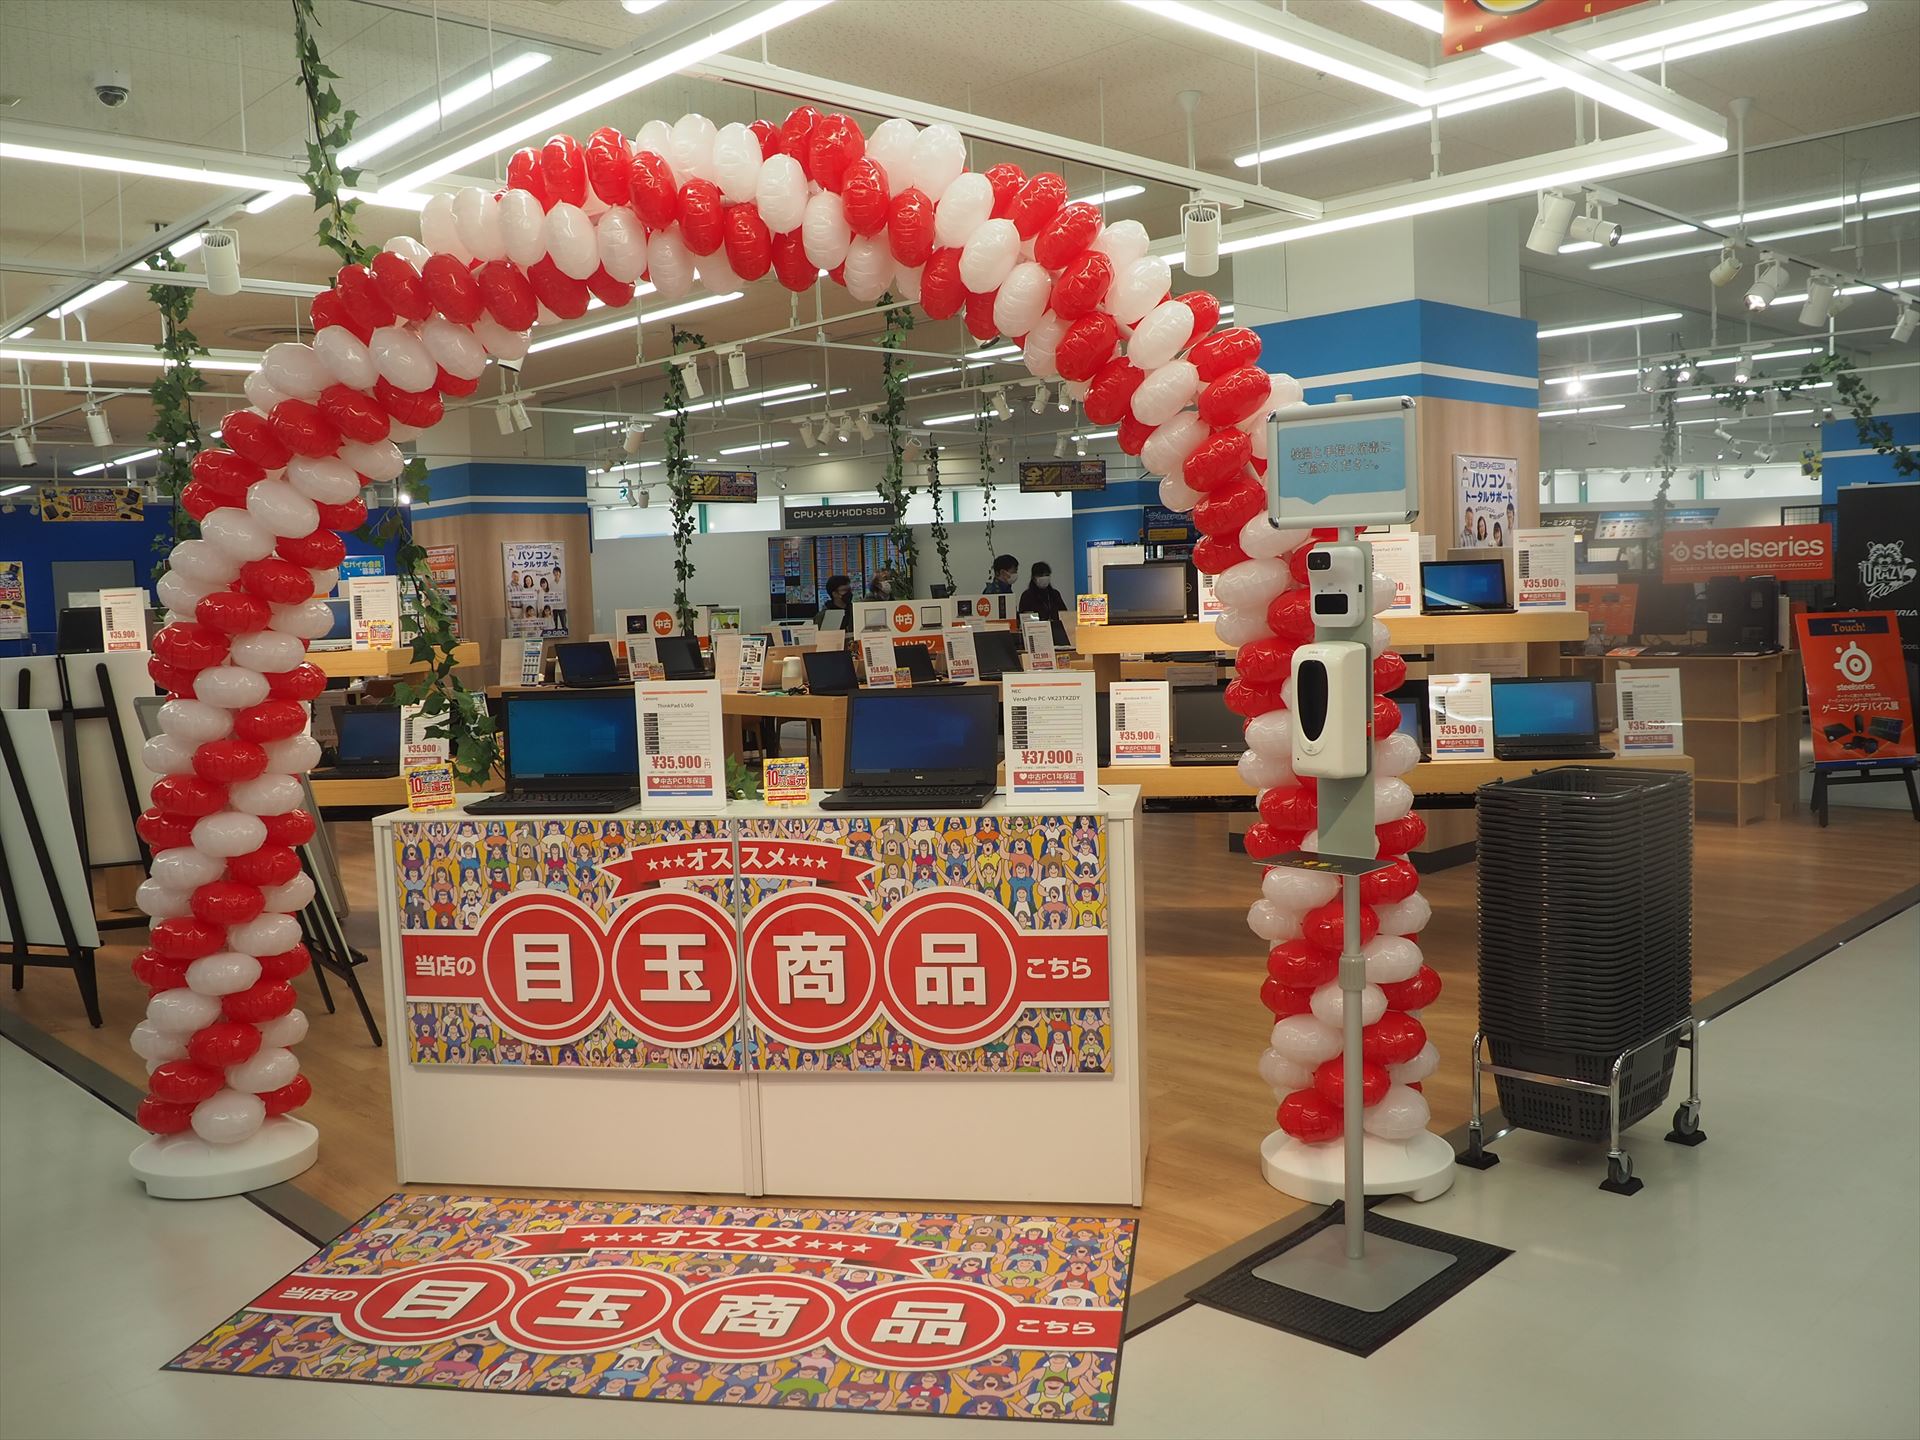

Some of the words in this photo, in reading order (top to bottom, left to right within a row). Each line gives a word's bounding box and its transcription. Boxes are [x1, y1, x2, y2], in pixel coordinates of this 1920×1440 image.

[1472, 473, 1506, 488] パソコン
[1465, 490, 1513, 503] トータルサポート
[1692, 536, 1825, 561] steelseries
[518, 551, 552, 560] パソコン
[511, 561, 560, 569] トータルサポート
[1523, 579, 1559, 589] ¥35,900
[977, 604, 990, 613] 中古
[655, 619, 671, 630] 中古
[895, 614, 913, 626] 中古
[1832, 622, 1866, 633] Touch!
[1440, 724, 1477, 735] ¥35,900
[1119, 731, 1154, 741] ¥35,900
[407, 744, 437, 753] ¥35,900
[652, 755, 702, 770] ¥35,900
[1021, 750, 1073, 765] ¥37,900
[660, 777, 706, 785] 中古PC1年保証
[1027, 772, 1077, 781] 中古PC1年保証
[686, 846, 784, 873] オススメ
[414, 953, 477, 978] 当店の
[512, 932, 987, 1007] 目玉商品
[1025, 955, 1092, 979] こちら
[651, 1228, 804, 1253] オススメ
[278, 1284, 358, 1304] 当店の
[382, 1279, 969, 1347] 目玉商品
[1014, 1319, 1096, 1335] こちら
